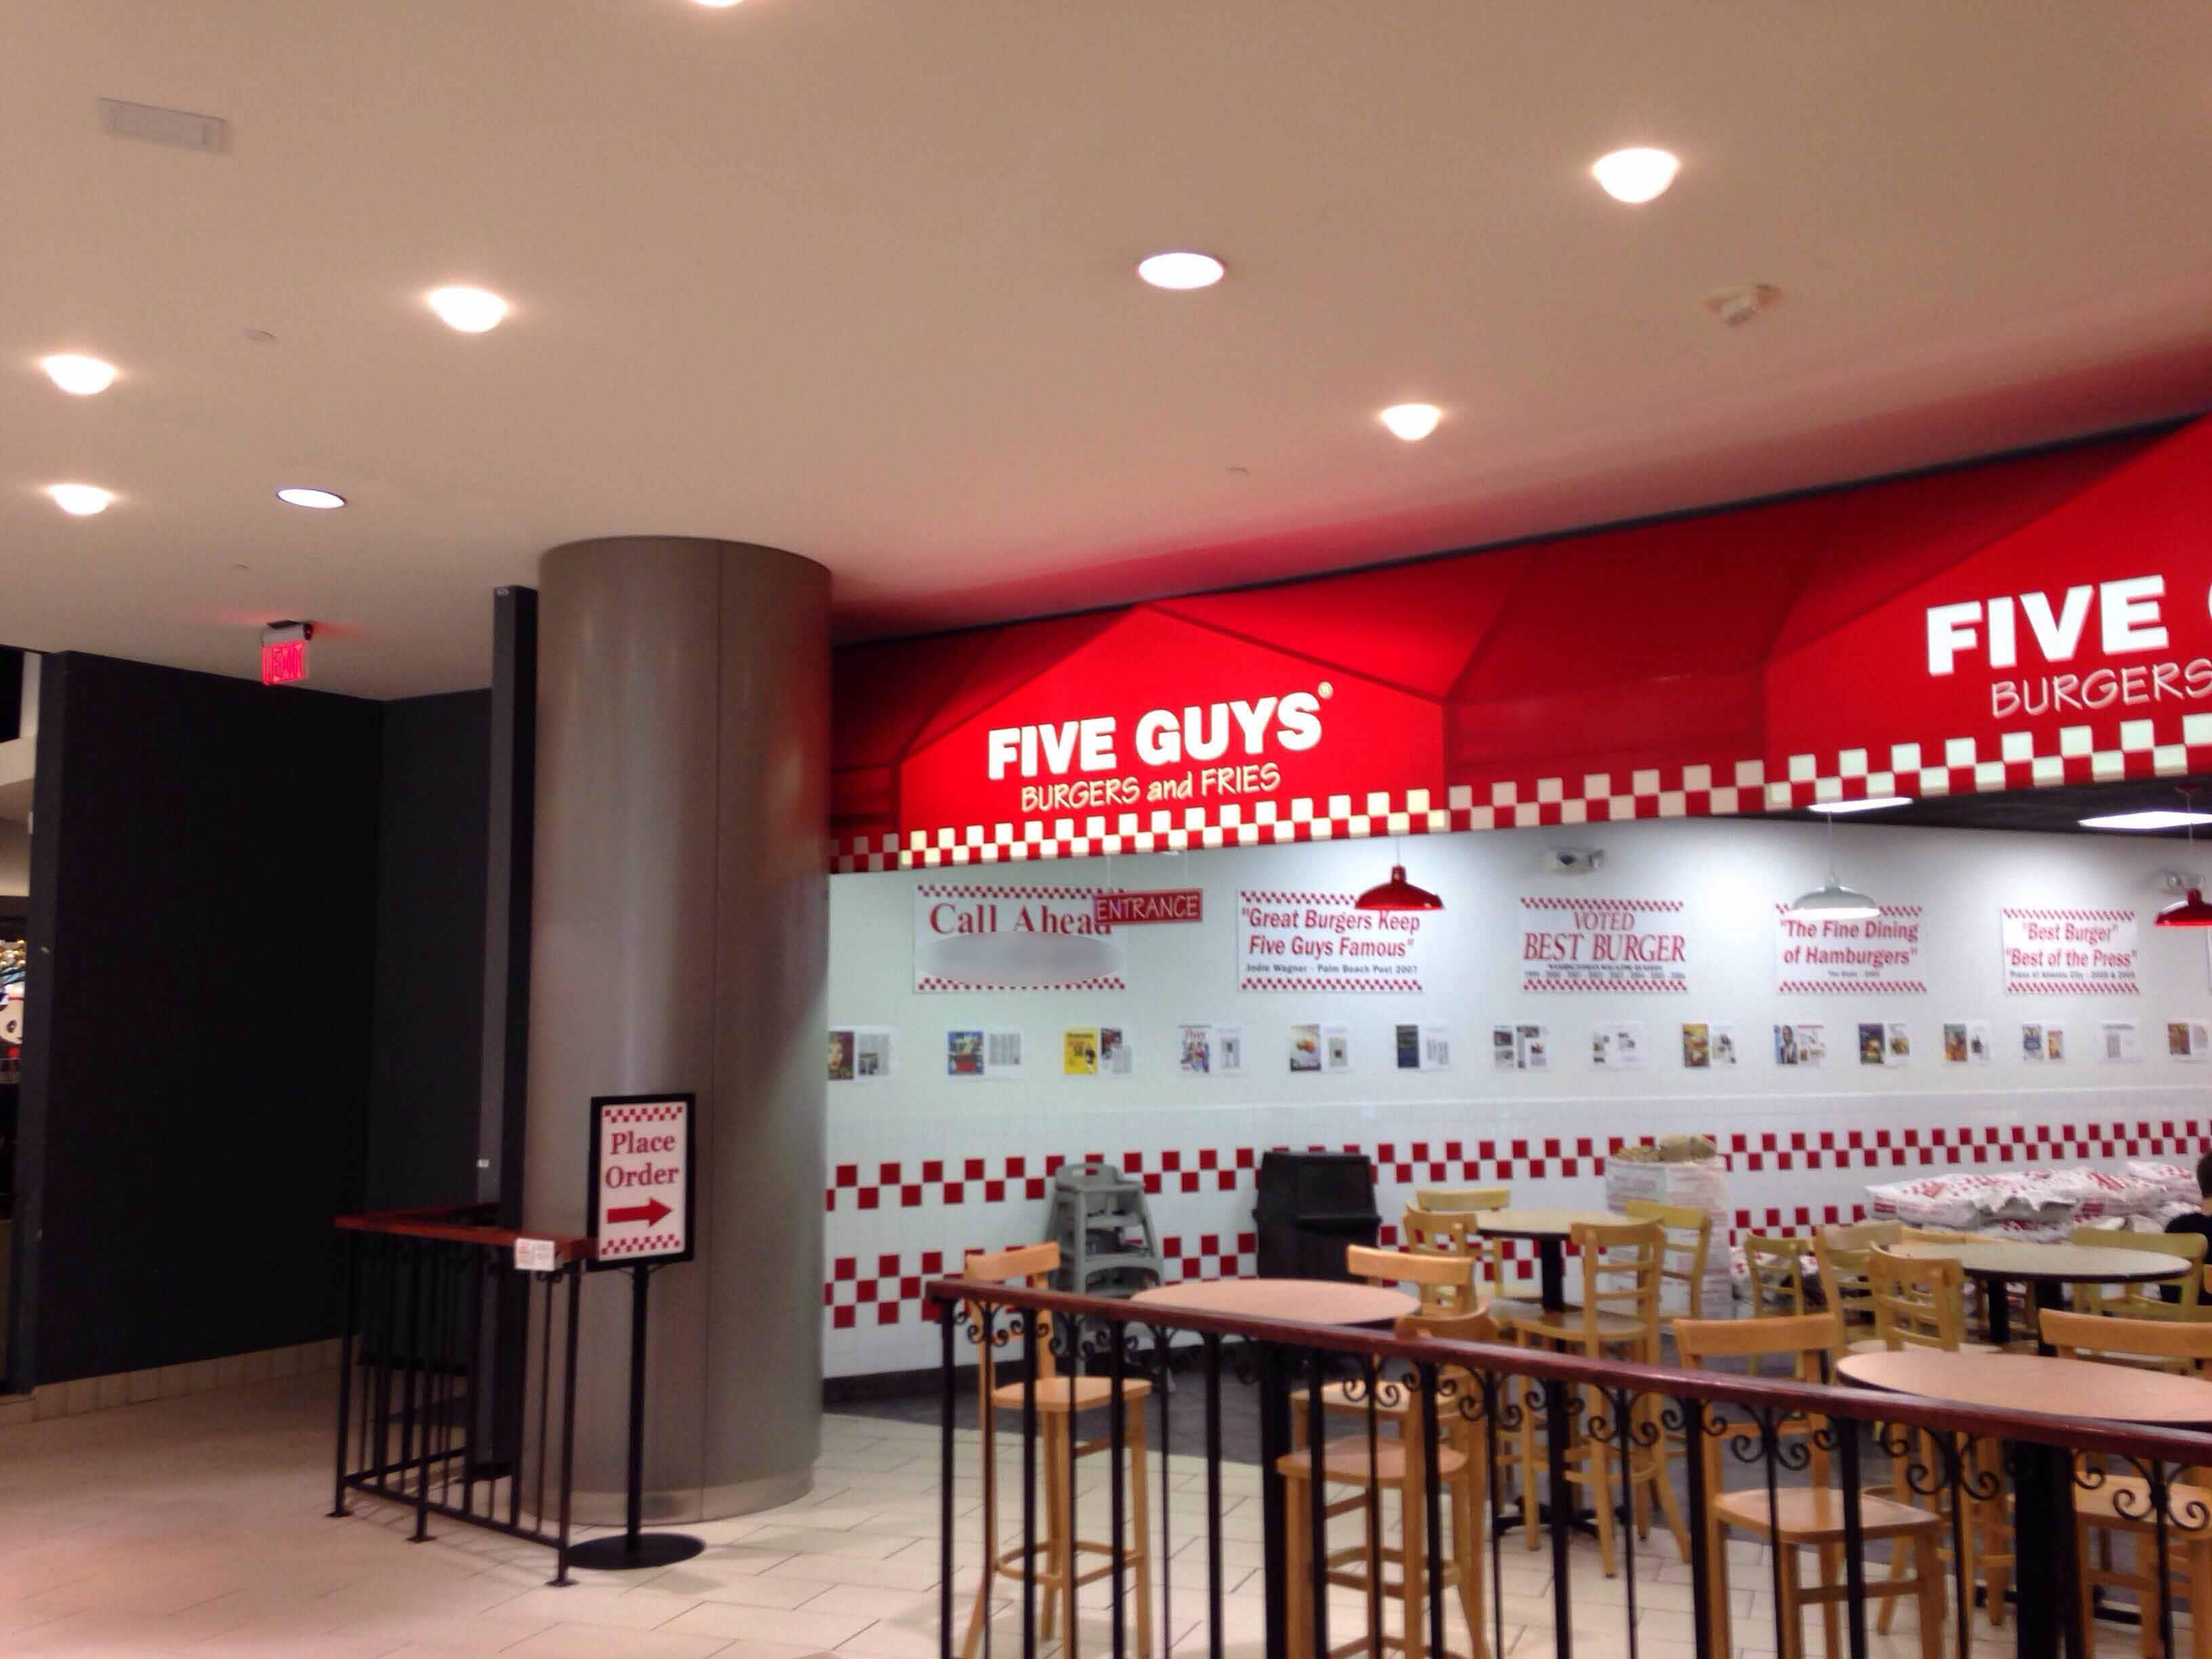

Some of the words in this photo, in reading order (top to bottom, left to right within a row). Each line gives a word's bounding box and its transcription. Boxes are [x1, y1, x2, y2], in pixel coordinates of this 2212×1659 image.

[1926, 575, 2169, 676] FIVE
[1991, 658, 2212, 719] BURGERS
[987, 716, 1117, 780] FIVE
[1135, 691, 1322, 765] GUYS
[1021, 777, 1140, 813] BURGERS
[1147, 771, 1193, 801] and
[1202, 762, 1282, 796] FRIES
[929, 902, 998, 934] Call
[1097, 894, 1200, 921] ENTRANCE
[1305, 909, 1372, 934] Burgers
[1378, 909, 1420, 935] Keep
[1573, 912, 1635, 931] VOTED
[1822, 920, 1860, 939] Fine
[1865, 922, 1919, 943] Dining
[1248, 935, 1286, 956] Five
[1291, 935, 1334, 960] Guys
[1523, 933, 1584, 961] BEST
[1593, 933, 1686, 962] BURGER
[1784, 947, 1800, 964] of
[2048, 949, 2062, 966] of
[2066, 949, 2089, 967] the
[610, 1130, 676, 1155] Place
[605, 1162, 680, 1189] Order
